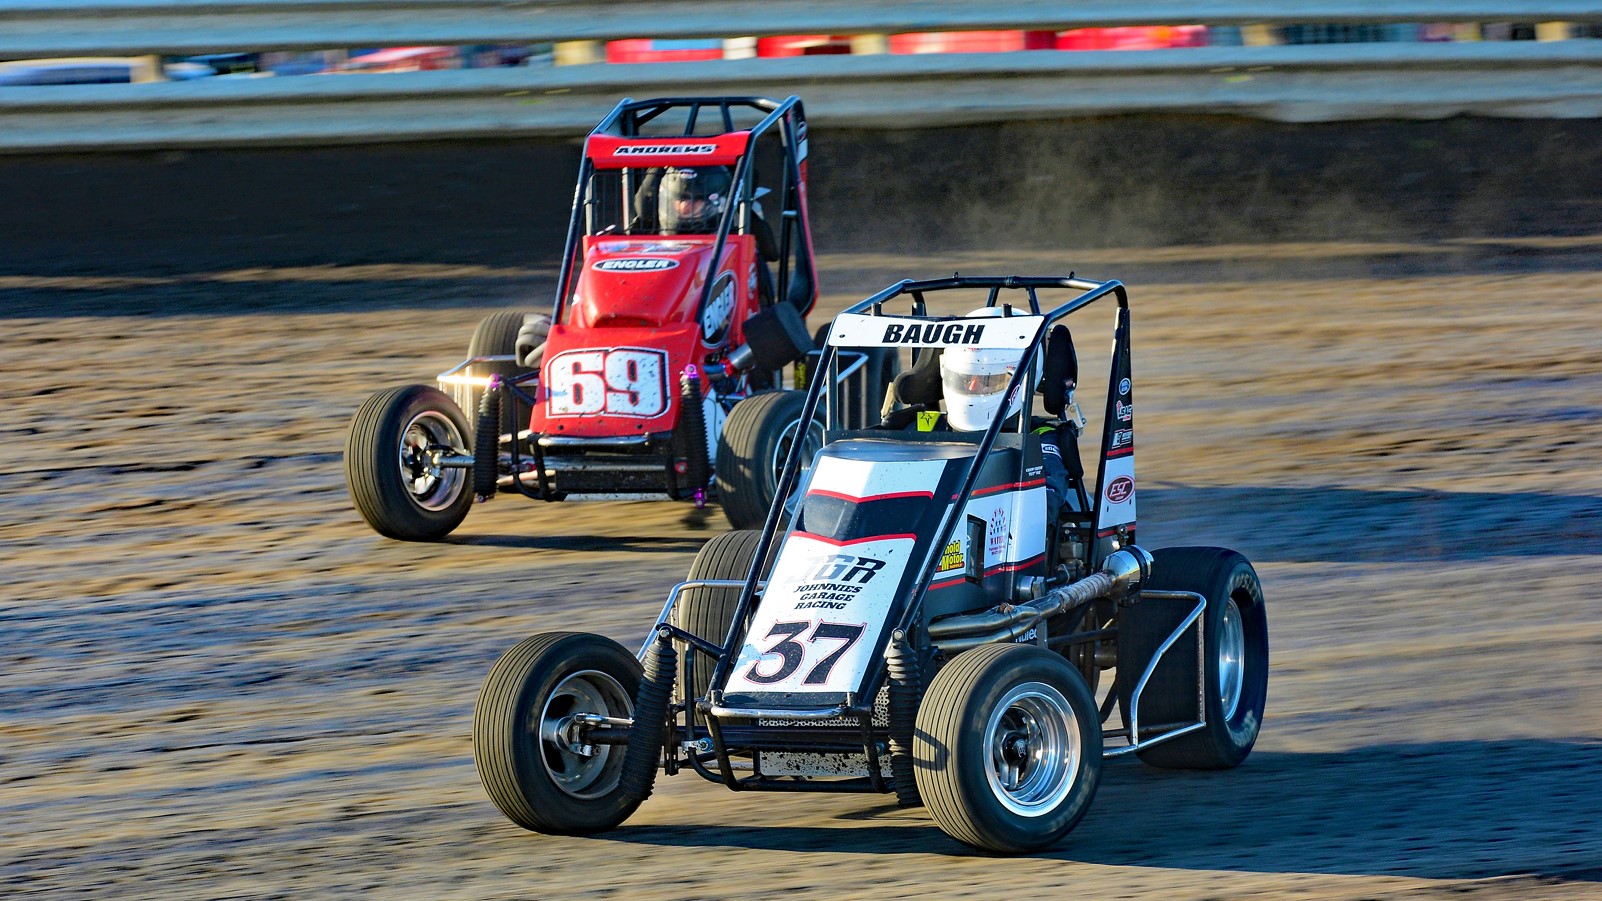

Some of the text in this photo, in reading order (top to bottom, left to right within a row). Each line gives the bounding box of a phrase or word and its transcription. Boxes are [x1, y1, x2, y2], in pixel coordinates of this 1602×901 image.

[614, 145, 717, 155] ANDREWS
[601, 259, 670, 269] ENGLER
[882, 324, 985, 344] BAUGH
[549, 349, 666, 417] 69
[1109, 480, 1131, 497] ESC
[944, 539, 961, 554] nold
[941, 553, 964, 571] Motor
[793, 583, 863, 593] JOHNNIES
[800, 592, 856, 602] GARAGE
[794, 600, 847, 610] RACING
[743, 619, 868, 685] 37
